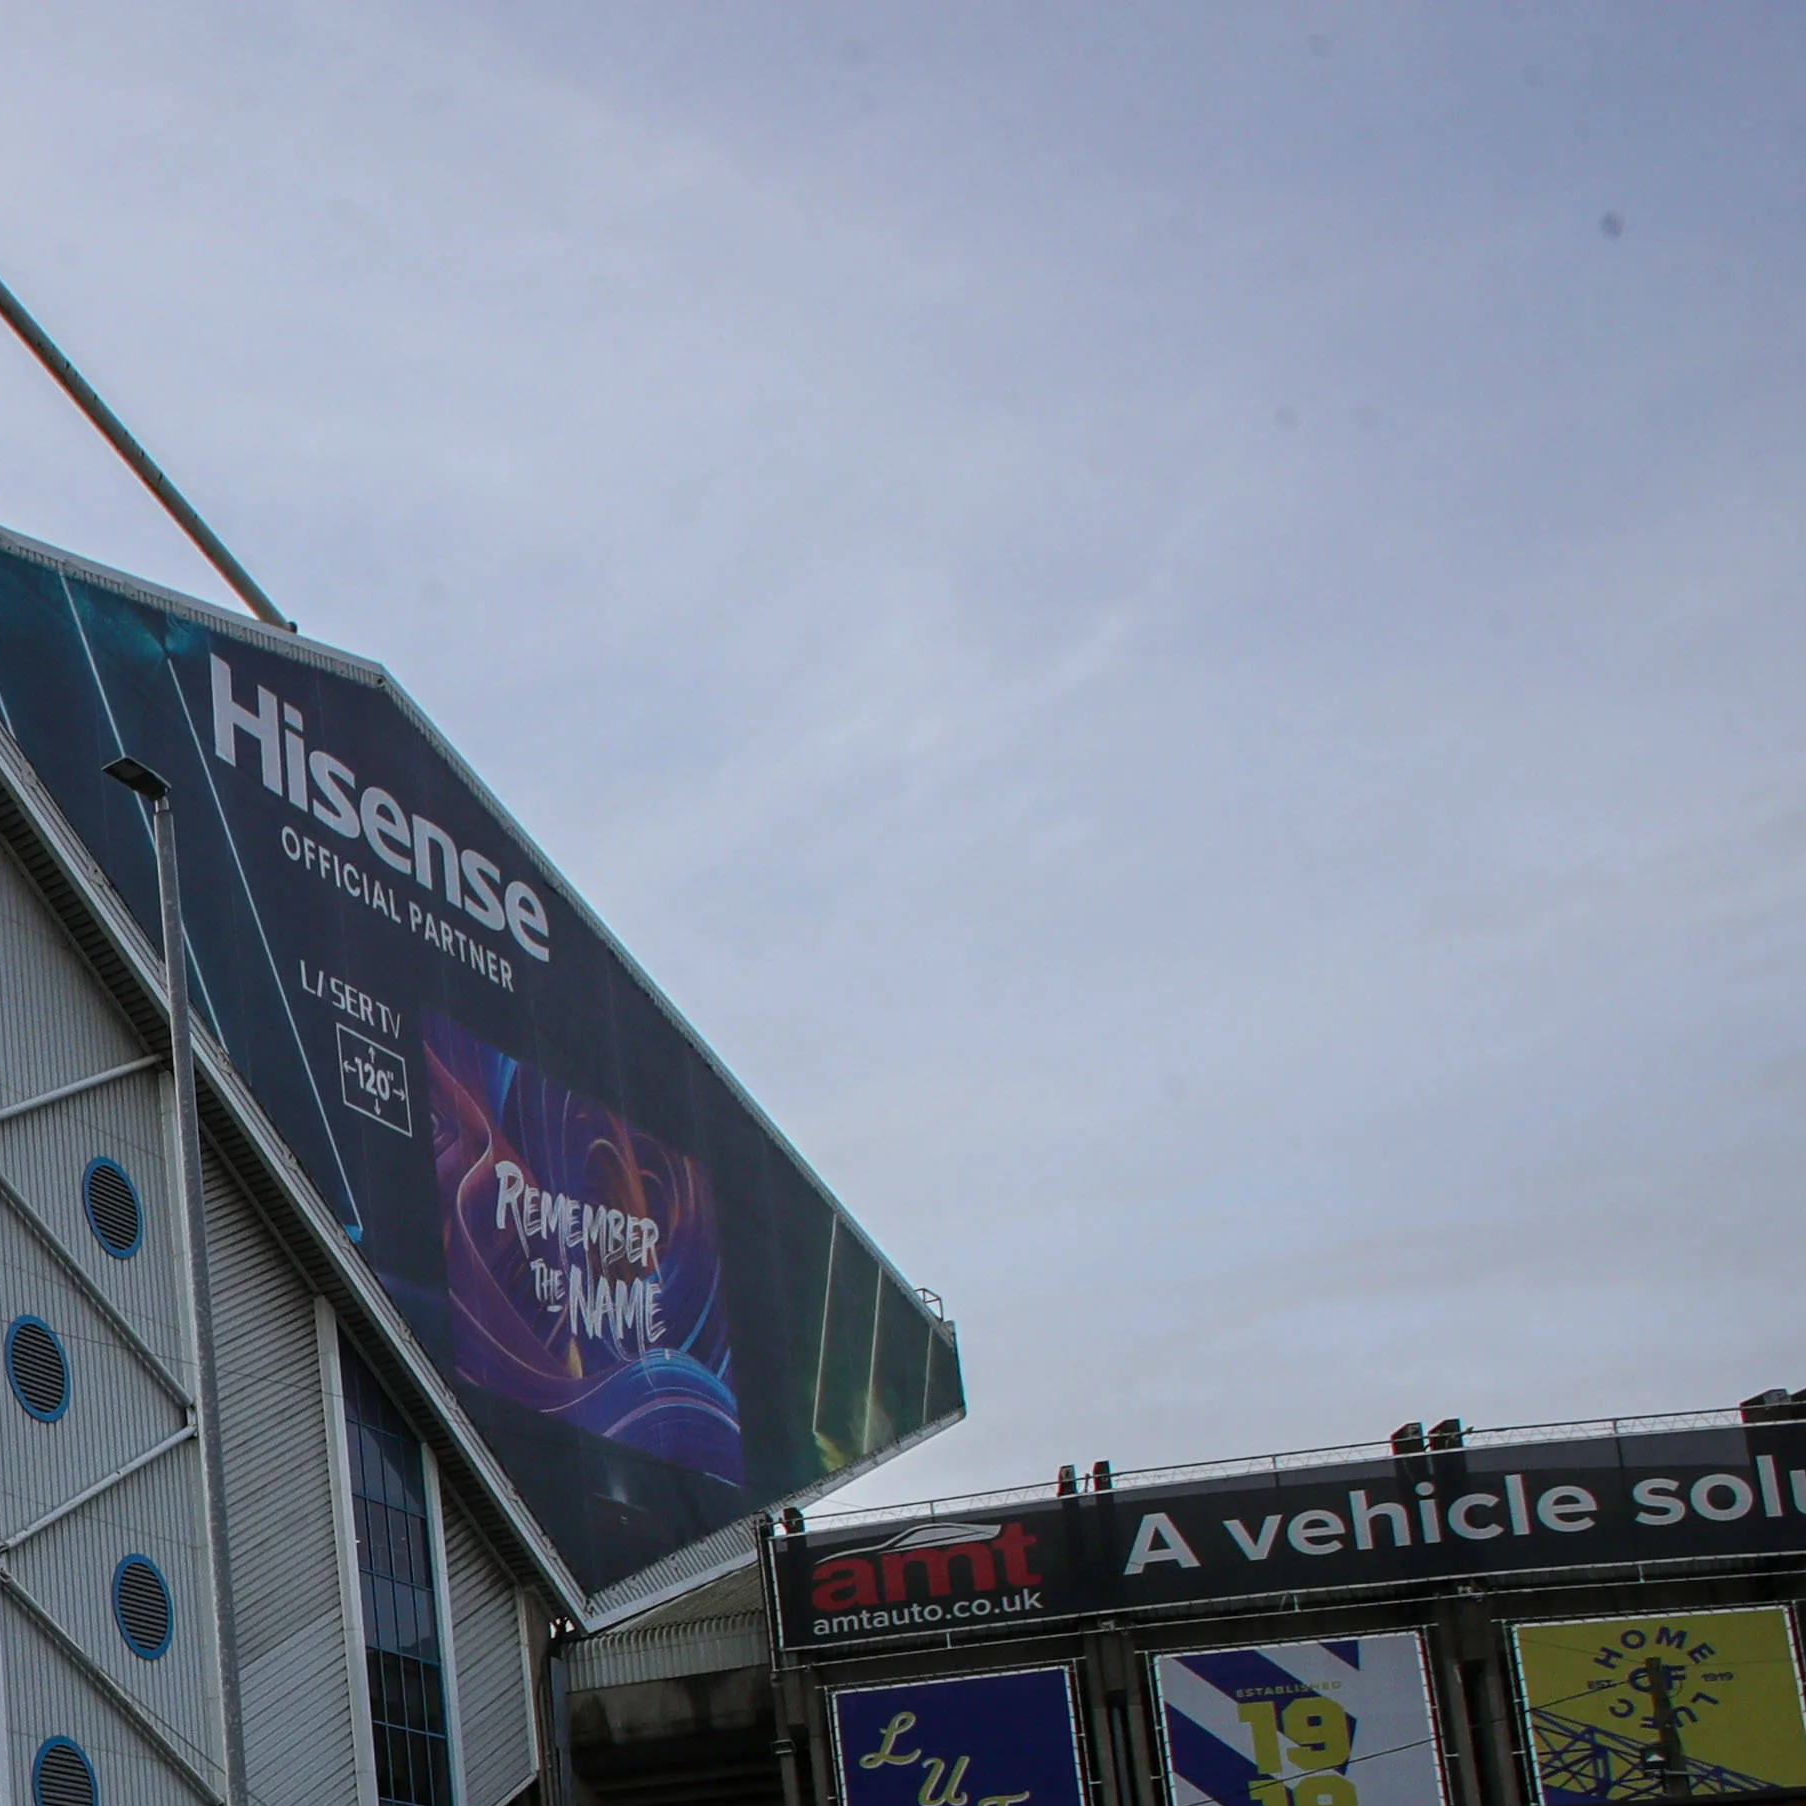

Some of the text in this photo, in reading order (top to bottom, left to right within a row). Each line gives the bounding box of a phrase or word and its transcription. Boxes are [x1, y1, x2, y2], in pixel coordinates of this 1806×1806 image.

[210, 652, 550, 962] Hisense
[281, 826, 514, 993] OFFICIAL PARTNER
[494, 1160, 662, 1275] REMEMBER
[530, 1258, 667, 1348] THE NAME
[812, 1523, 1043, 1611] amt
[1123, 1511, 1201, 1576] A
[1223, 1473, 1597, 1562] vehicle
[813, 1587, 1044, 1636] amtauto.co.uk
[1593, 1626, 1716, 1669] HOME
[1235, 1681, 1343, 1698] ESTABLISHED
[1237, 1697, 1352, 1775] 19
